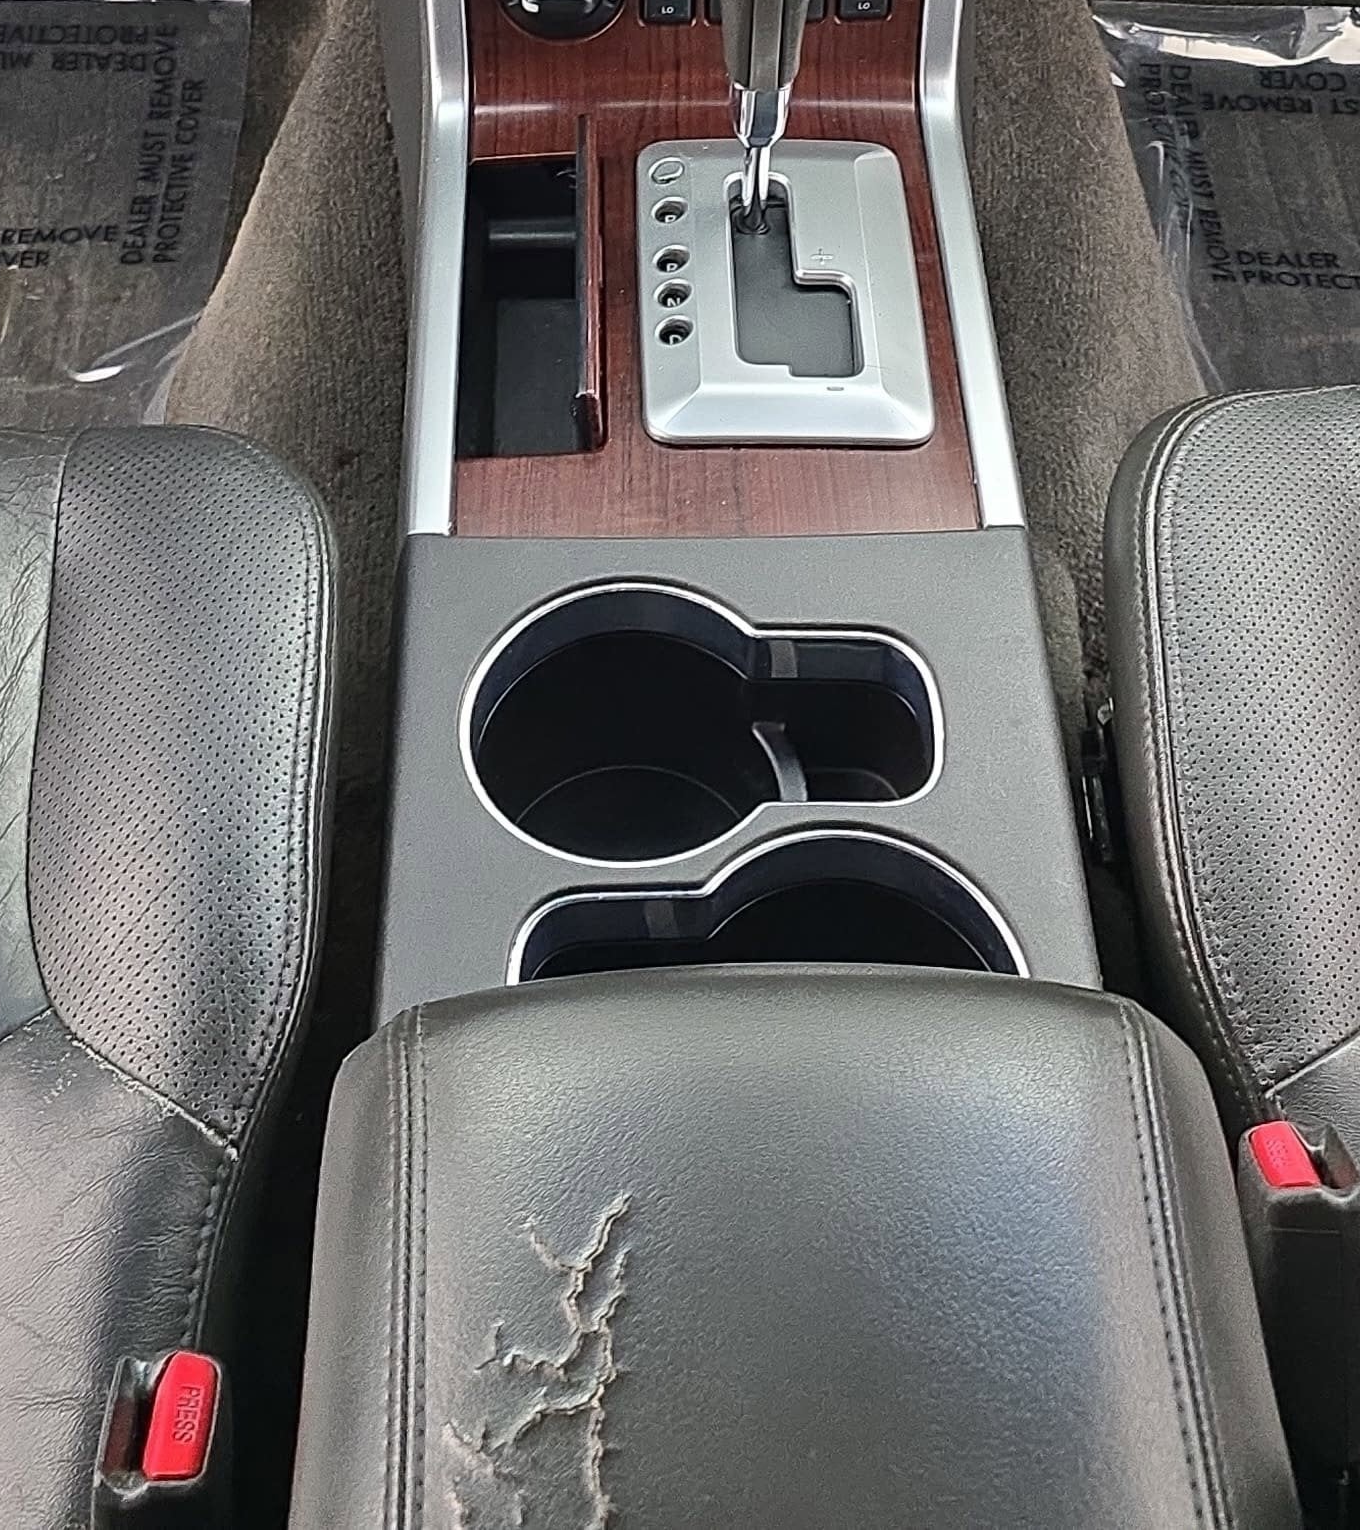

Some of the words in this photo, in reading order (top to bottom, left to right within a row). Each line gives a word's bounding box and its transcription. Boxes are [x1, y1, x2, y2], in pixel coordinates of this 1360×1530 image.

[661, 6, 674, 14] LO
[858, 2, 871, 10] LO
[51, 50, 147, 70] DEALER
[147, 24, 178, 120] REMOVE
[1260, 70, 1347, 92] COVER
[1200, 92, 1312, 114] REMOVE
[138, 130, 167, 189] MUST
[152, 151, 196, 264] PROTECTIVE
[175, 77, 207, 147] COVER
[1, 224, 122, 245] REMOVE
[120, 192, 150, 266] DEALER
[1237, 250, 1340, 269] DEALER
[172, 1385, 203, 1445] PRESS
